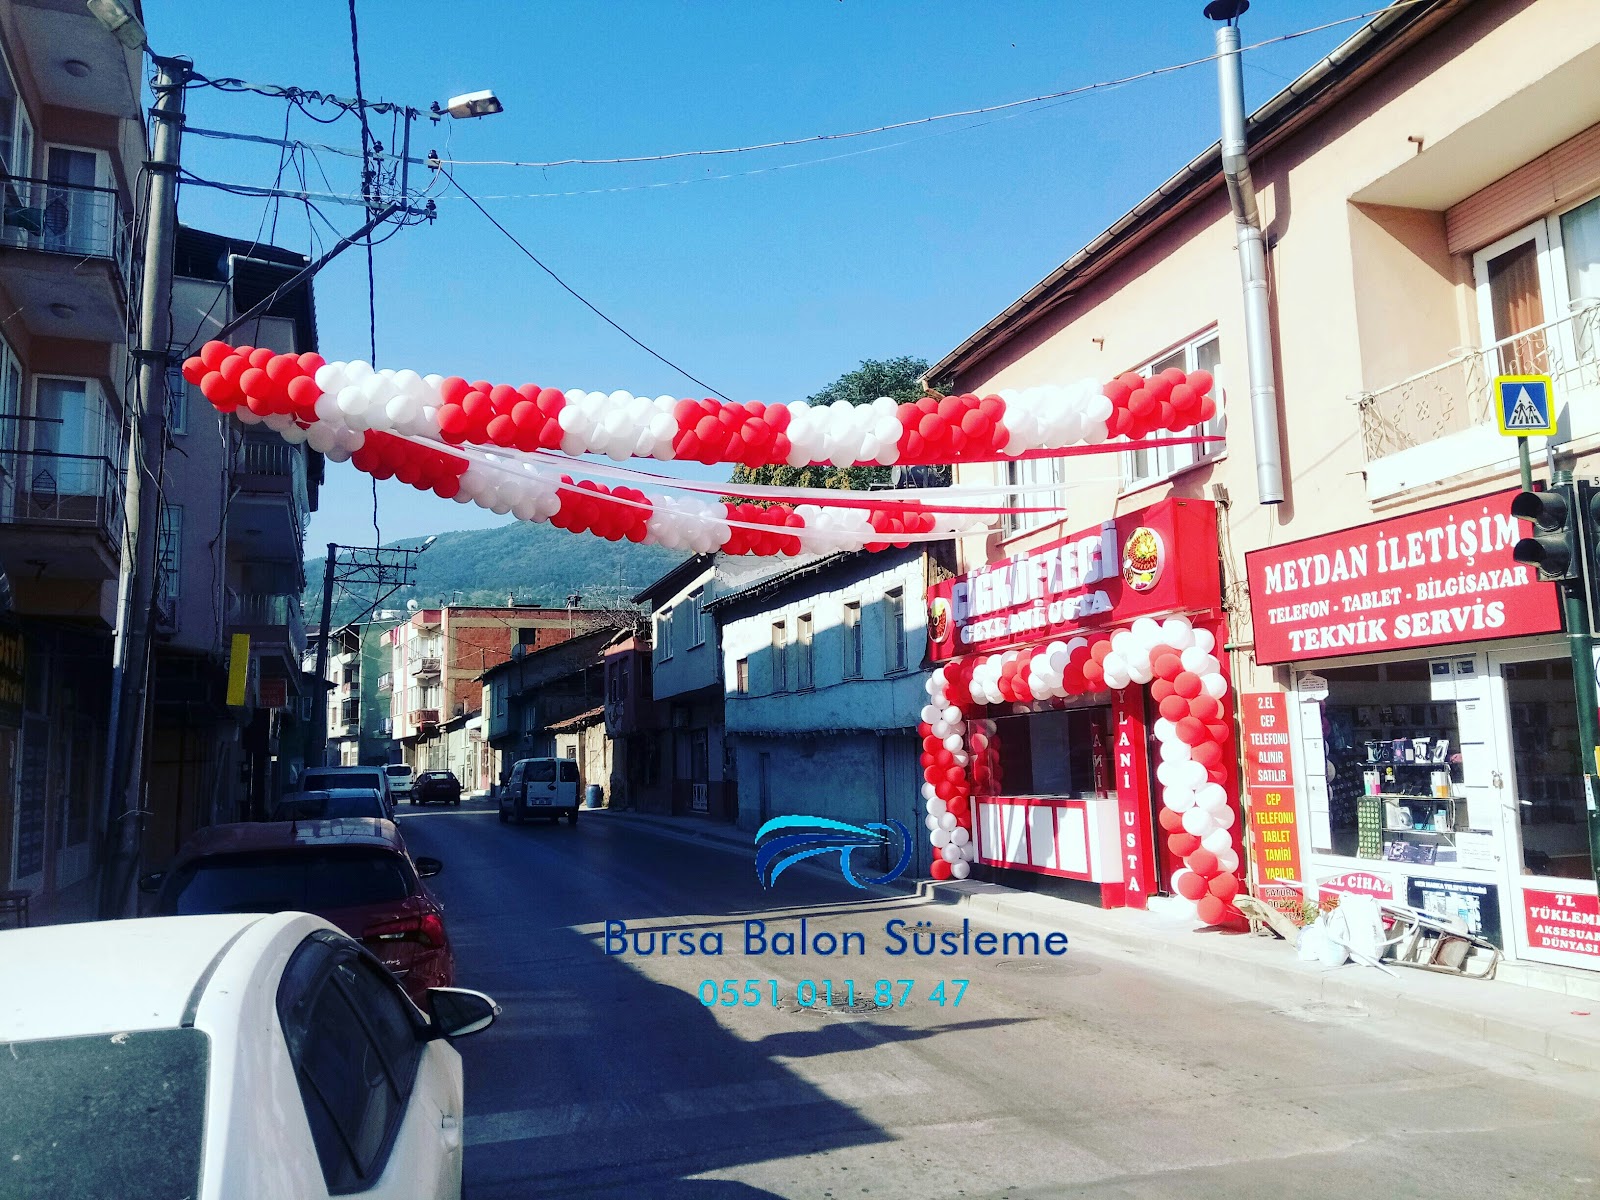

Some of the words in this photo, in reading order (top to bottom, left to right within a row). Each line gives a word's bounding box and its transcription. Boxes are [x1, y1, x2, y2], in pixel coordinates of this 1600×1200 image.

[1265, 544, 1368, 595] MEYDAN
[1377, 507, 1520, 572] İLETİŞİM
[1268, 599, 1330, 624] TELEFON
[1342, 587, 1401, 612] TABLET
[1416, 565, 1529, 601] BİLGİSAYAR
[1047, 590, 1113, 623] USTA
[1289, 615, 1386, 652] TEKNİK
[1394, 597, 1506, 639] SERVİS
[1257, 697, 1275, 709] 2.EL
[1260, 714, 1275, 727] CEP
[1250, 733, 1288, 745] TELEFONU
[1259, 751, 1283, 763] ALINIR
[1258, 769, 1286, 781] SATILIR
[1117, 690, 1131, 789] YLANİ
[1124, 811, 1140, 892] USTA
[1265, 793, 1281, 806] CEP
[1256, 812, 1294, 824] TELEFONU
[1262, 830, 1290, 842] TABLET
[1265, 846, 1291, 861] TAMİRİ
[1265, 867, 1294, 880] YAPILIR
[1347, 873, 1391, 893] CİHAZ
[1555, 894, 1576, 907] TL
[1542, 937, 1599, 954] DÜNYASI
